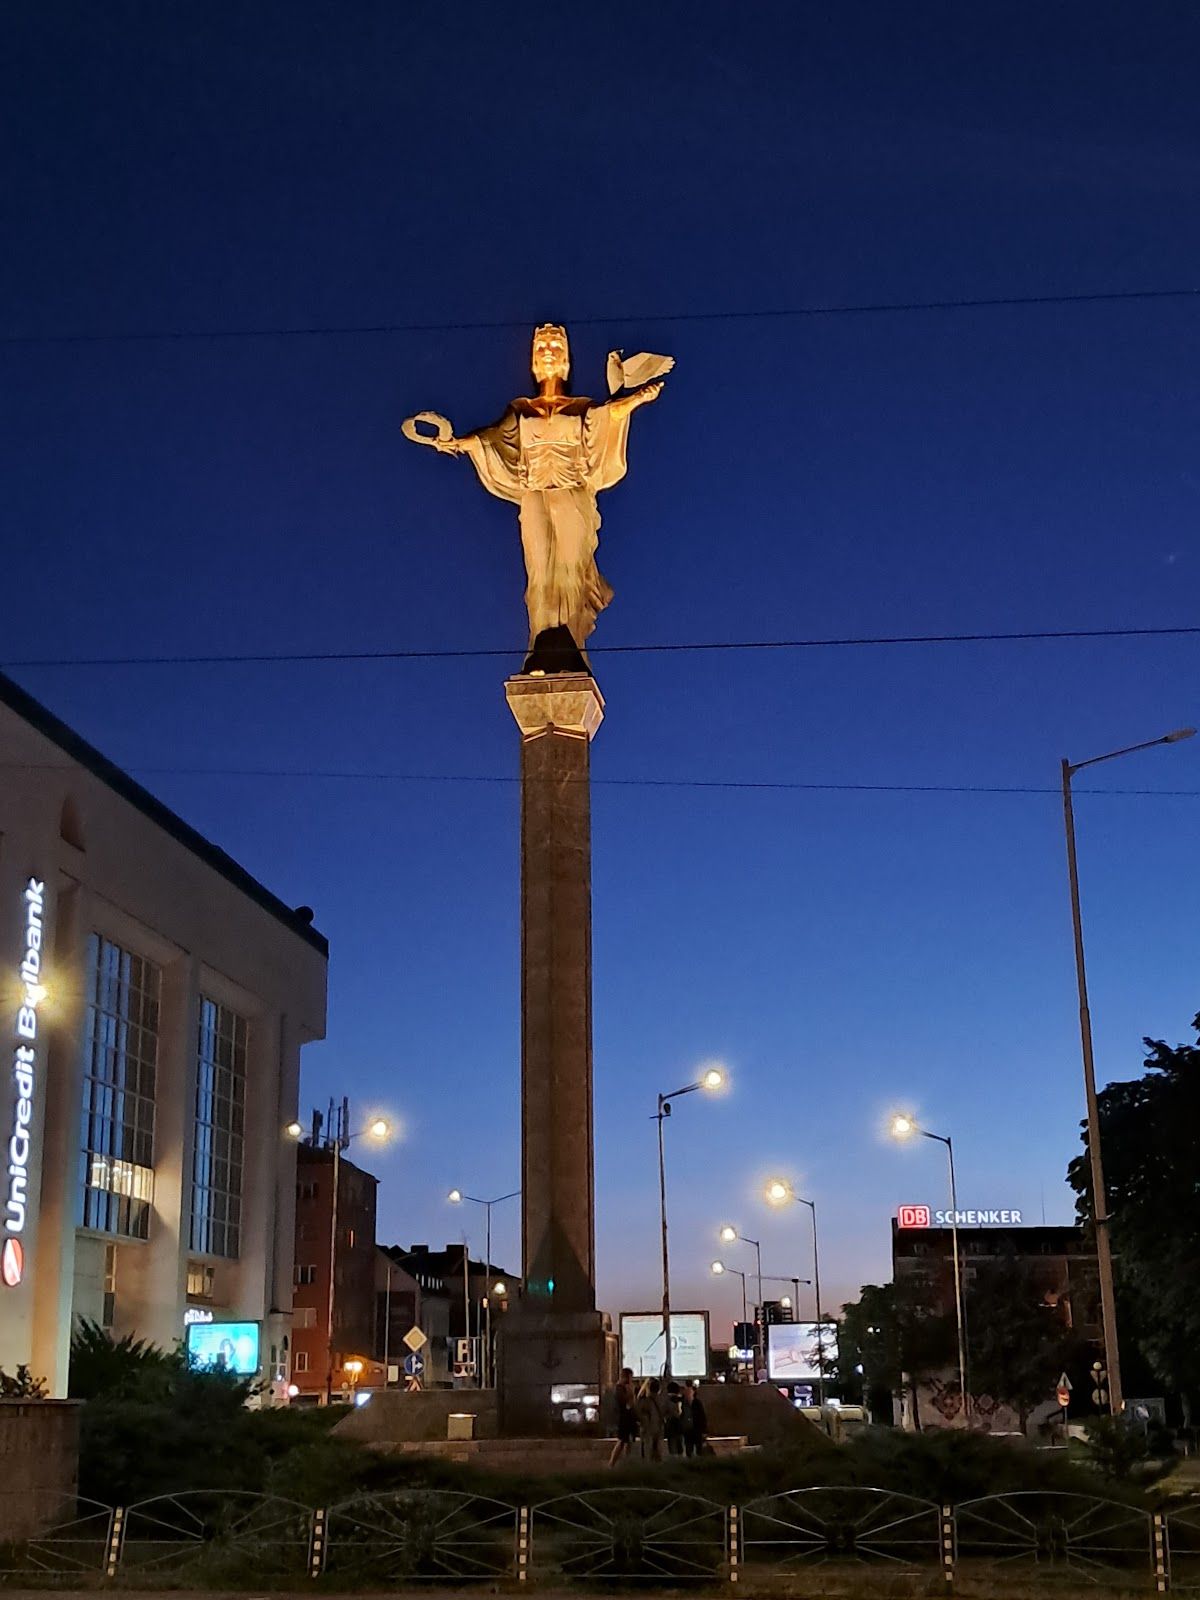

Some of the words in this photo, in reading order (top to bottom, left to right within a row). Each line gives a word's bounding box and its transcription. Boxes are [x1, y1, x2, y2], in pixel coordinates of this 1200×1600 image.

[5, 1045, 35, 1232] UniCredit
[903, 1209, 927, 1225] DB
[935, 1210, 1022, 1223] SCHENKER
